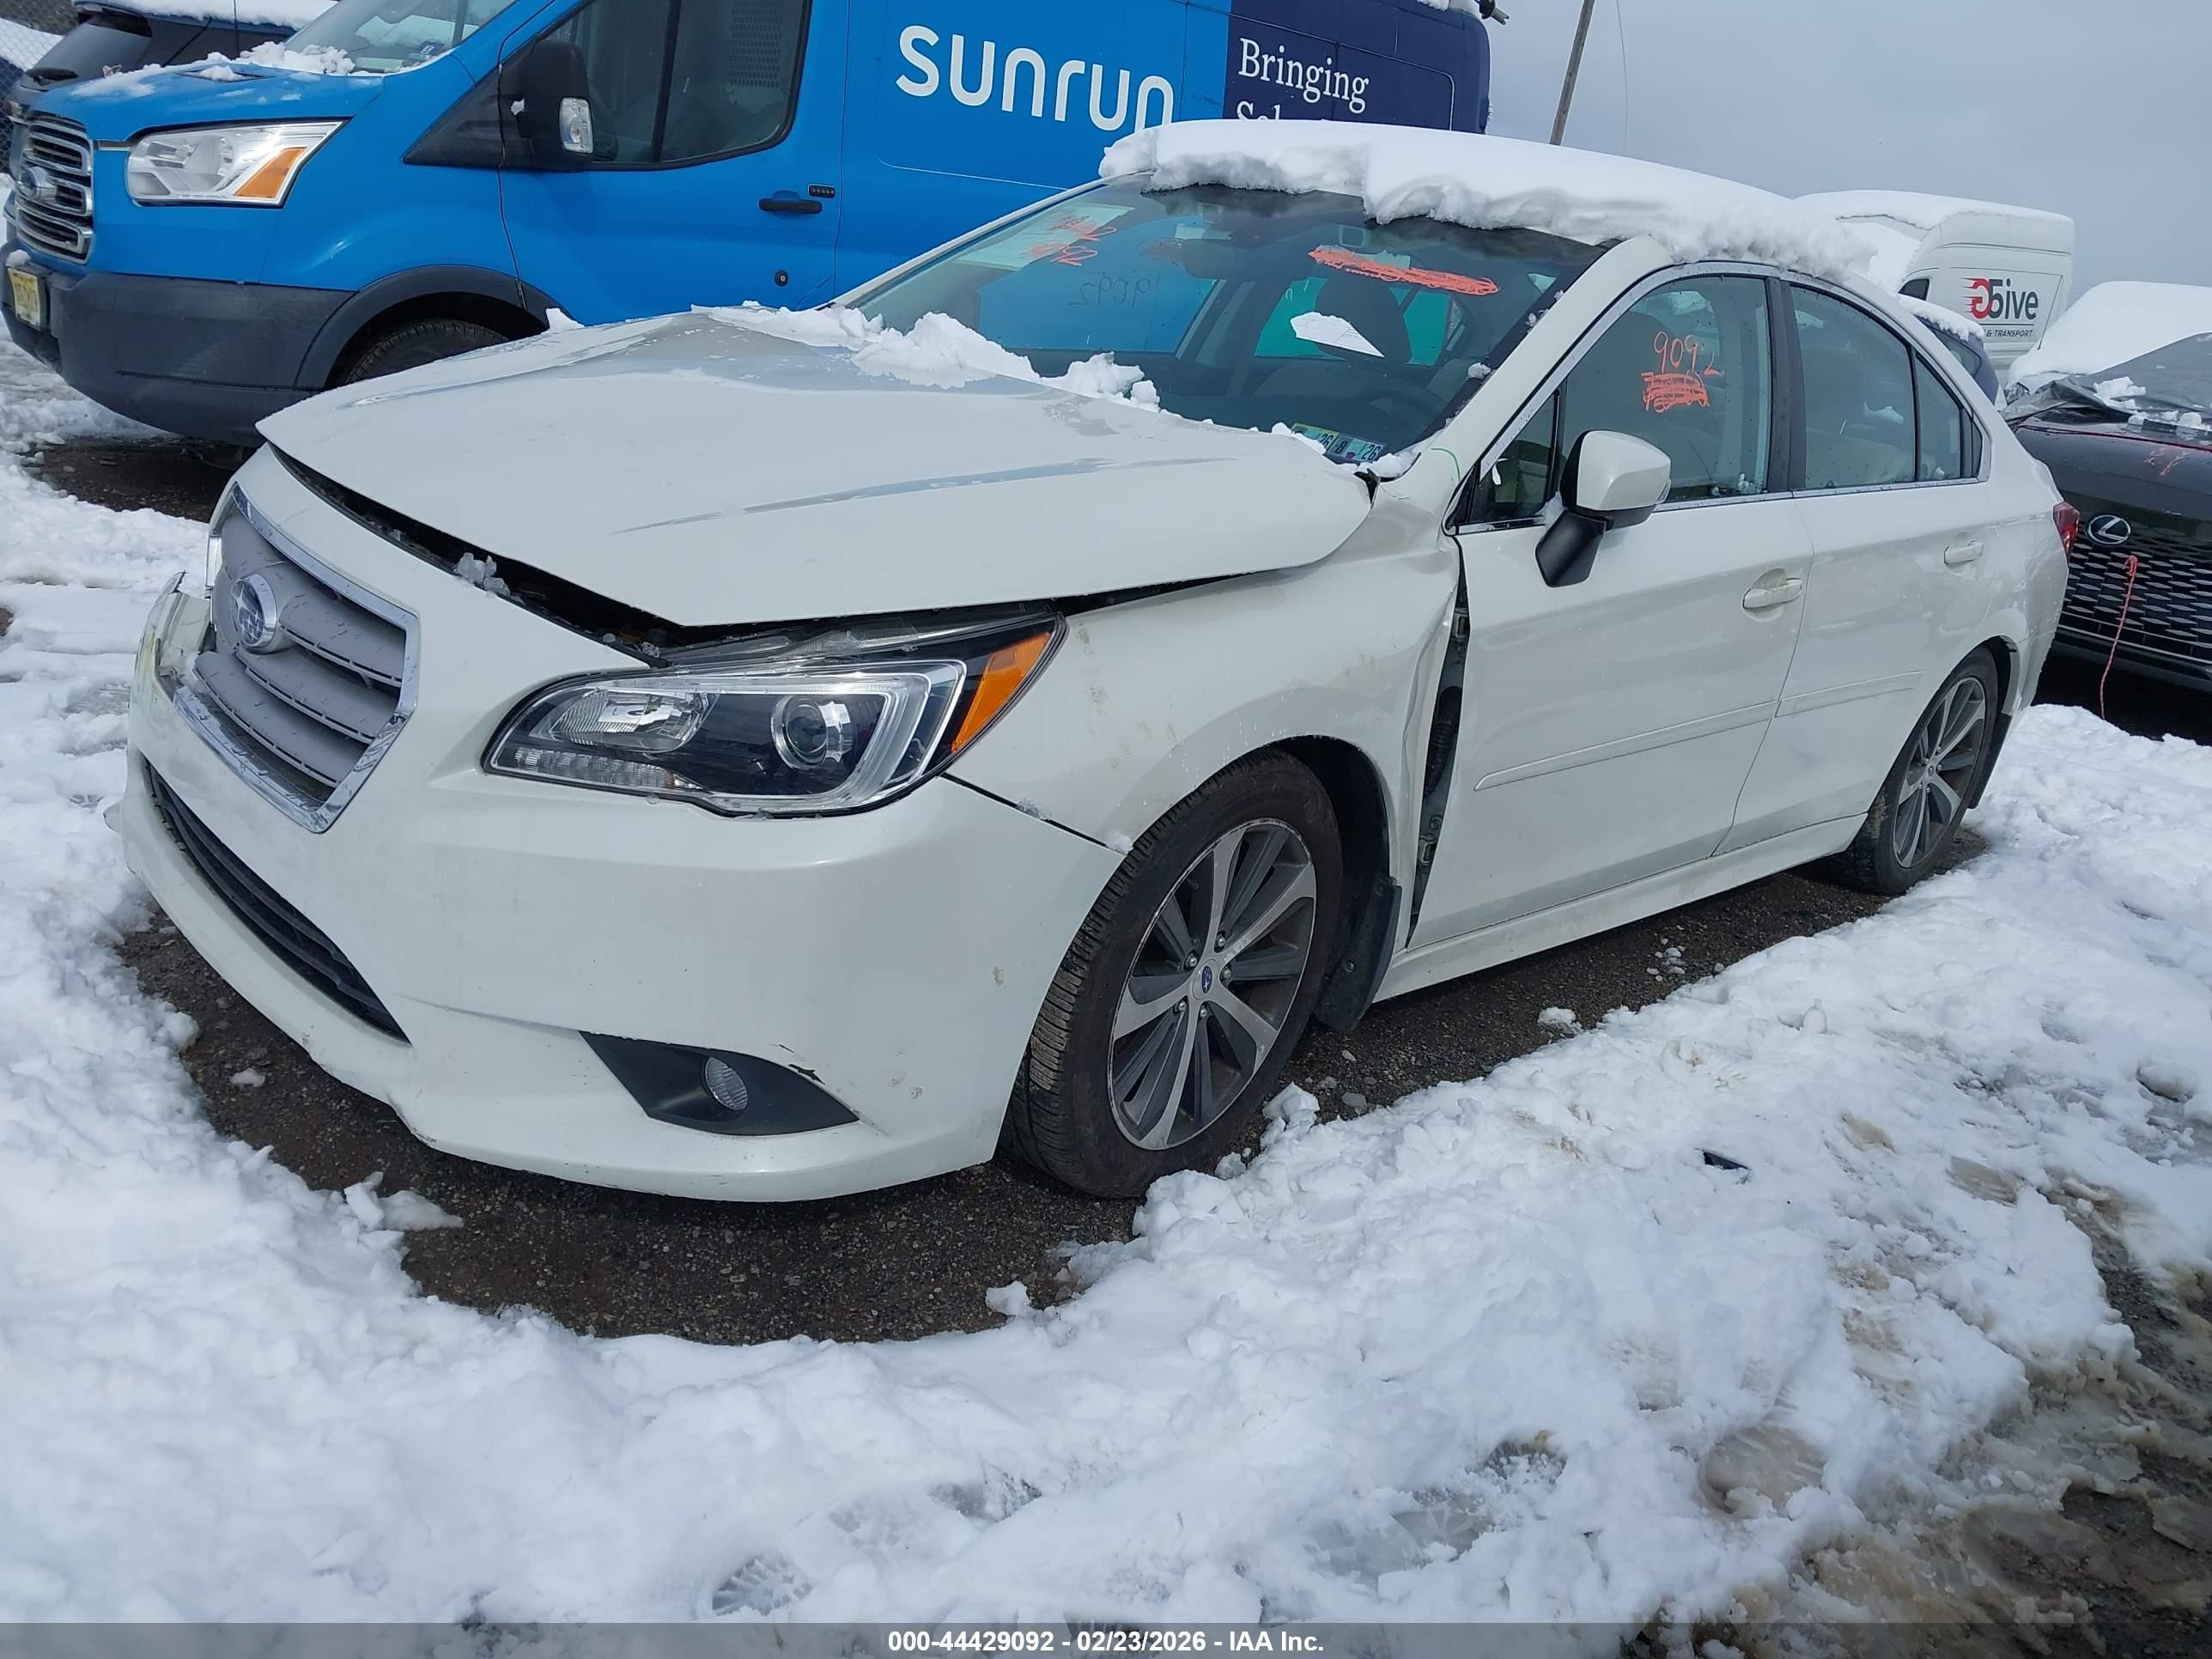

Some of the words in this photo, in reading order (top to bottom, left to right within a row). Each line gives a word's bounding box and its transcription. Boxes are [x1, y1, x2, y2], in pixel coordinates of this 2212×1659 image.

[1238, 37, 1370, 114] Bringing
[1994, 329, 2033, 337] TRANSPORT
[1653, 331, 1725, 376] 9092
[1334, 441, 1348, 454] 8
[1361, 444, 1382, 461] 26
